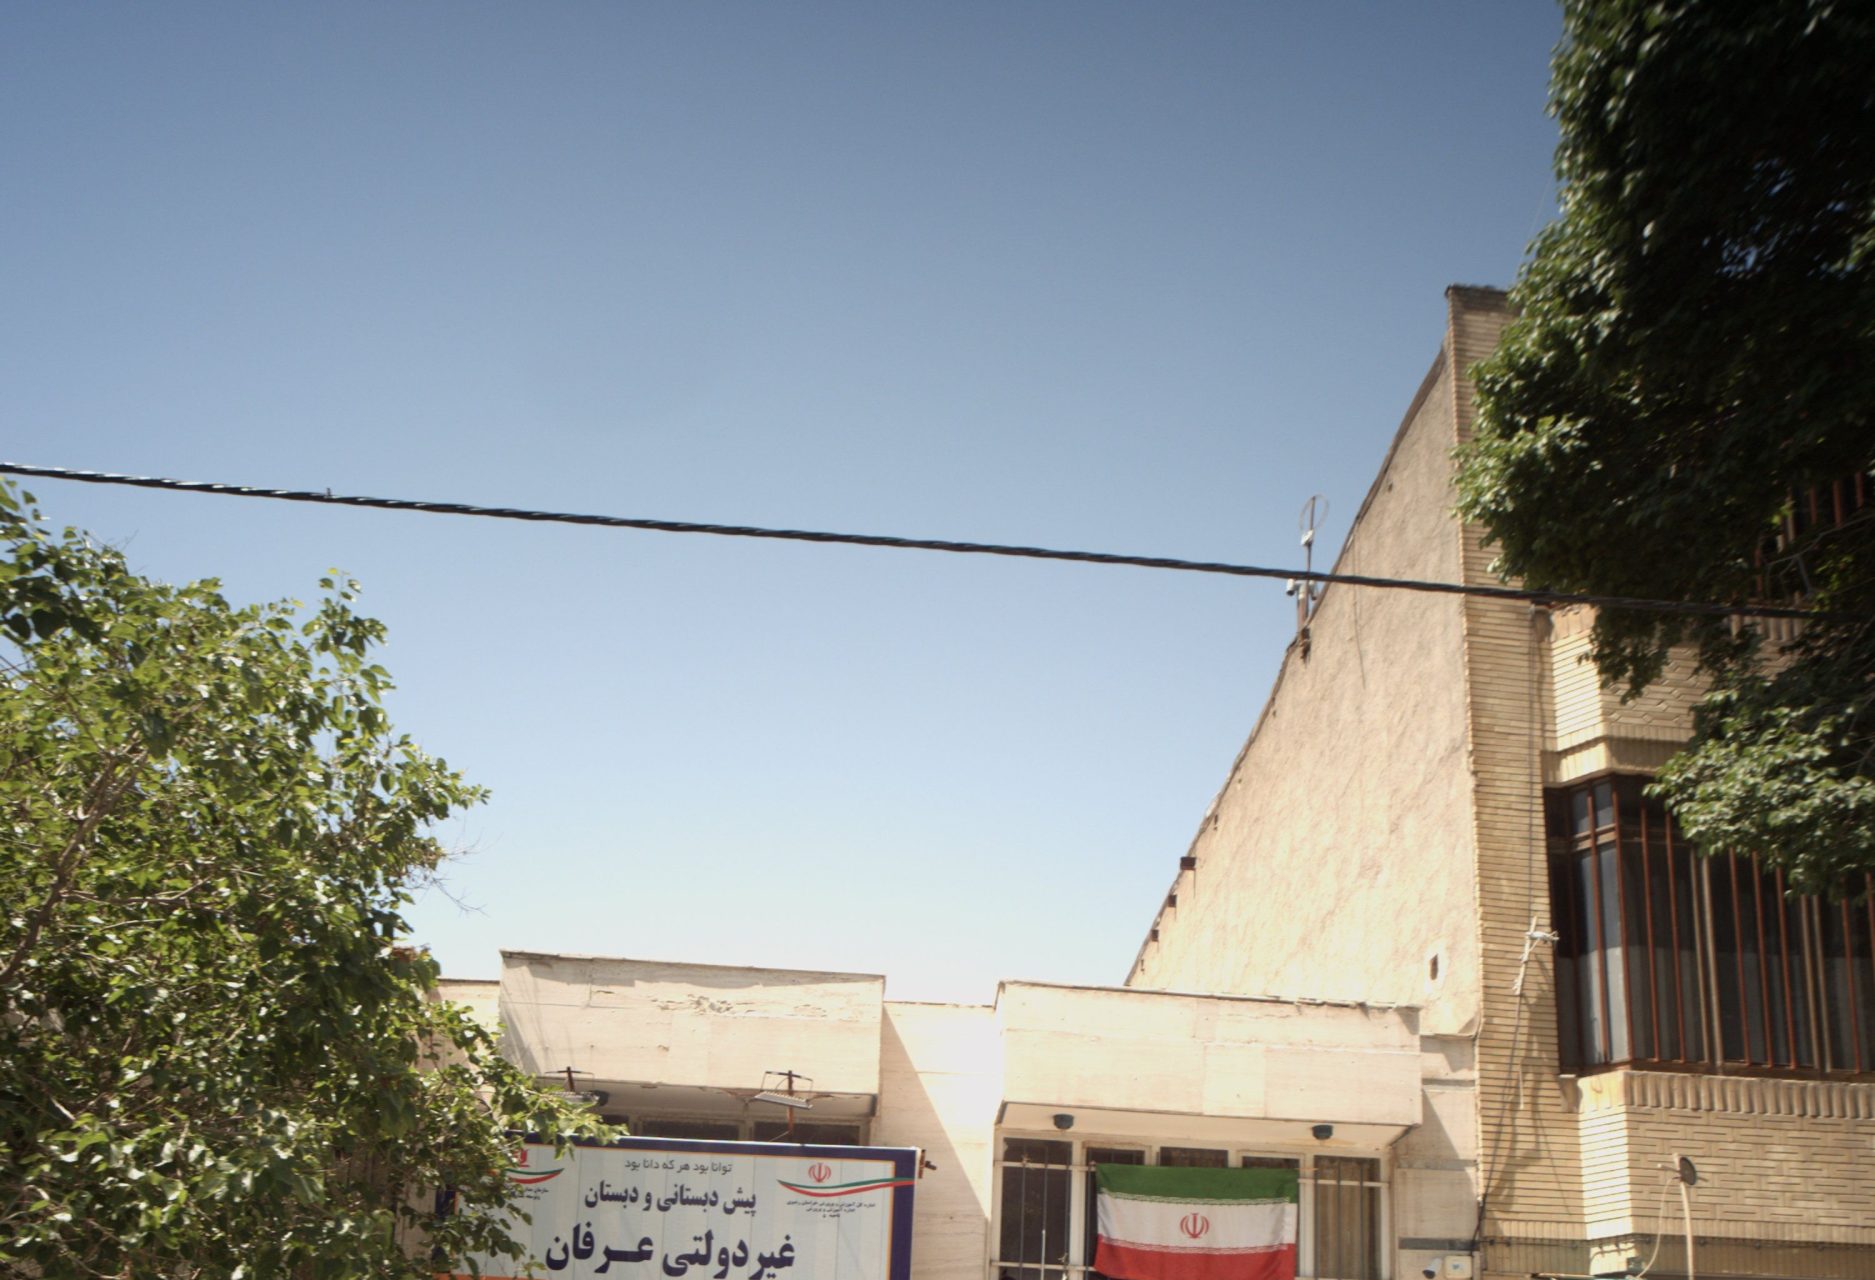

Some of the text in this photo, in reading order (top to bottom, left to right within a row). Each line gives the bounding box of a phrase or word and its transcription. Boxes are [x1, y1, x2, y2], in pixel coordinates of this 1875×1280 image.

[625, 1158, 732, 1175] توانا بود هر که دانا بود
[584, 1180, 757, 1217] پیش دبستانی و دبستان
